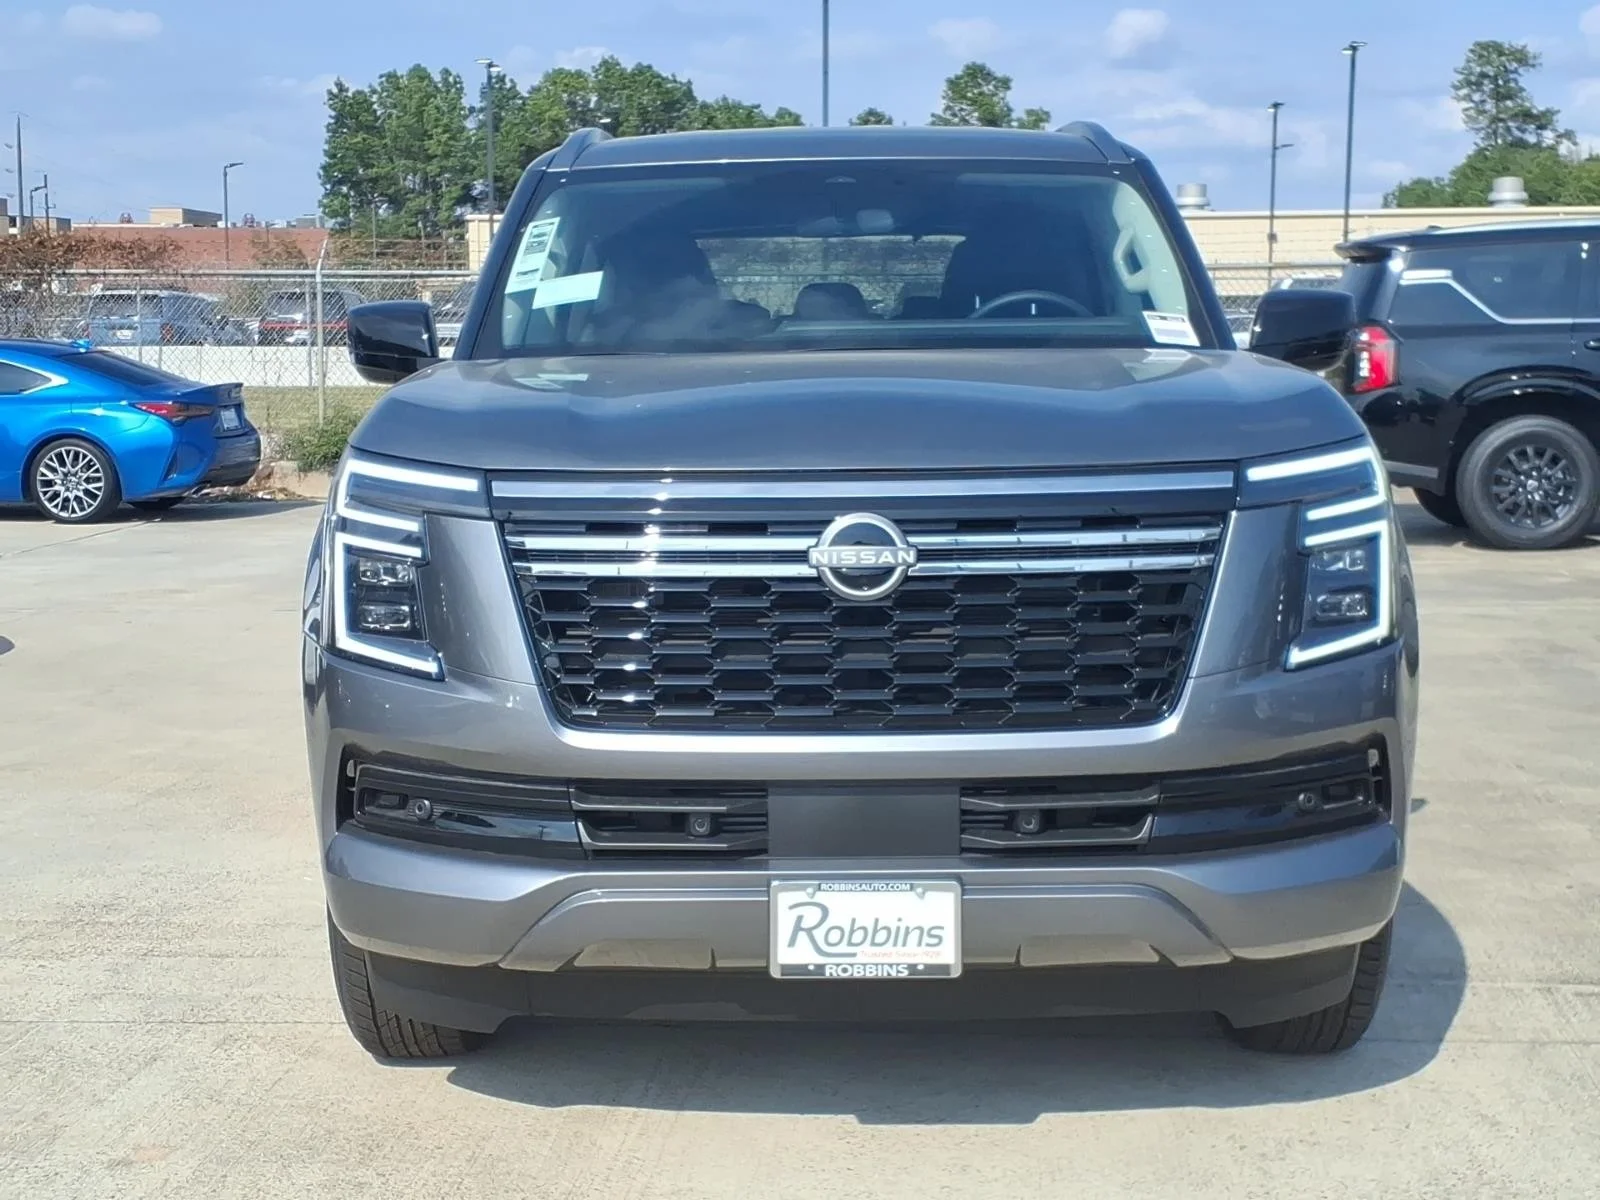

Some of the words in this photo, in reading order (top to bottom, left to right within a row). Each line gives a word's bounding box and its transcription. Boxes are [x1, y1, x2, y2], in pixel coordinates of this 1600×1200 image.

[812, 550, 915, 565] NISSAN
[820, 883, 911, 892] ROBBINSAUTO.COM
[786, 901, 945, 958] Robbins
[825, 964, 909, 977] ROBBINS
